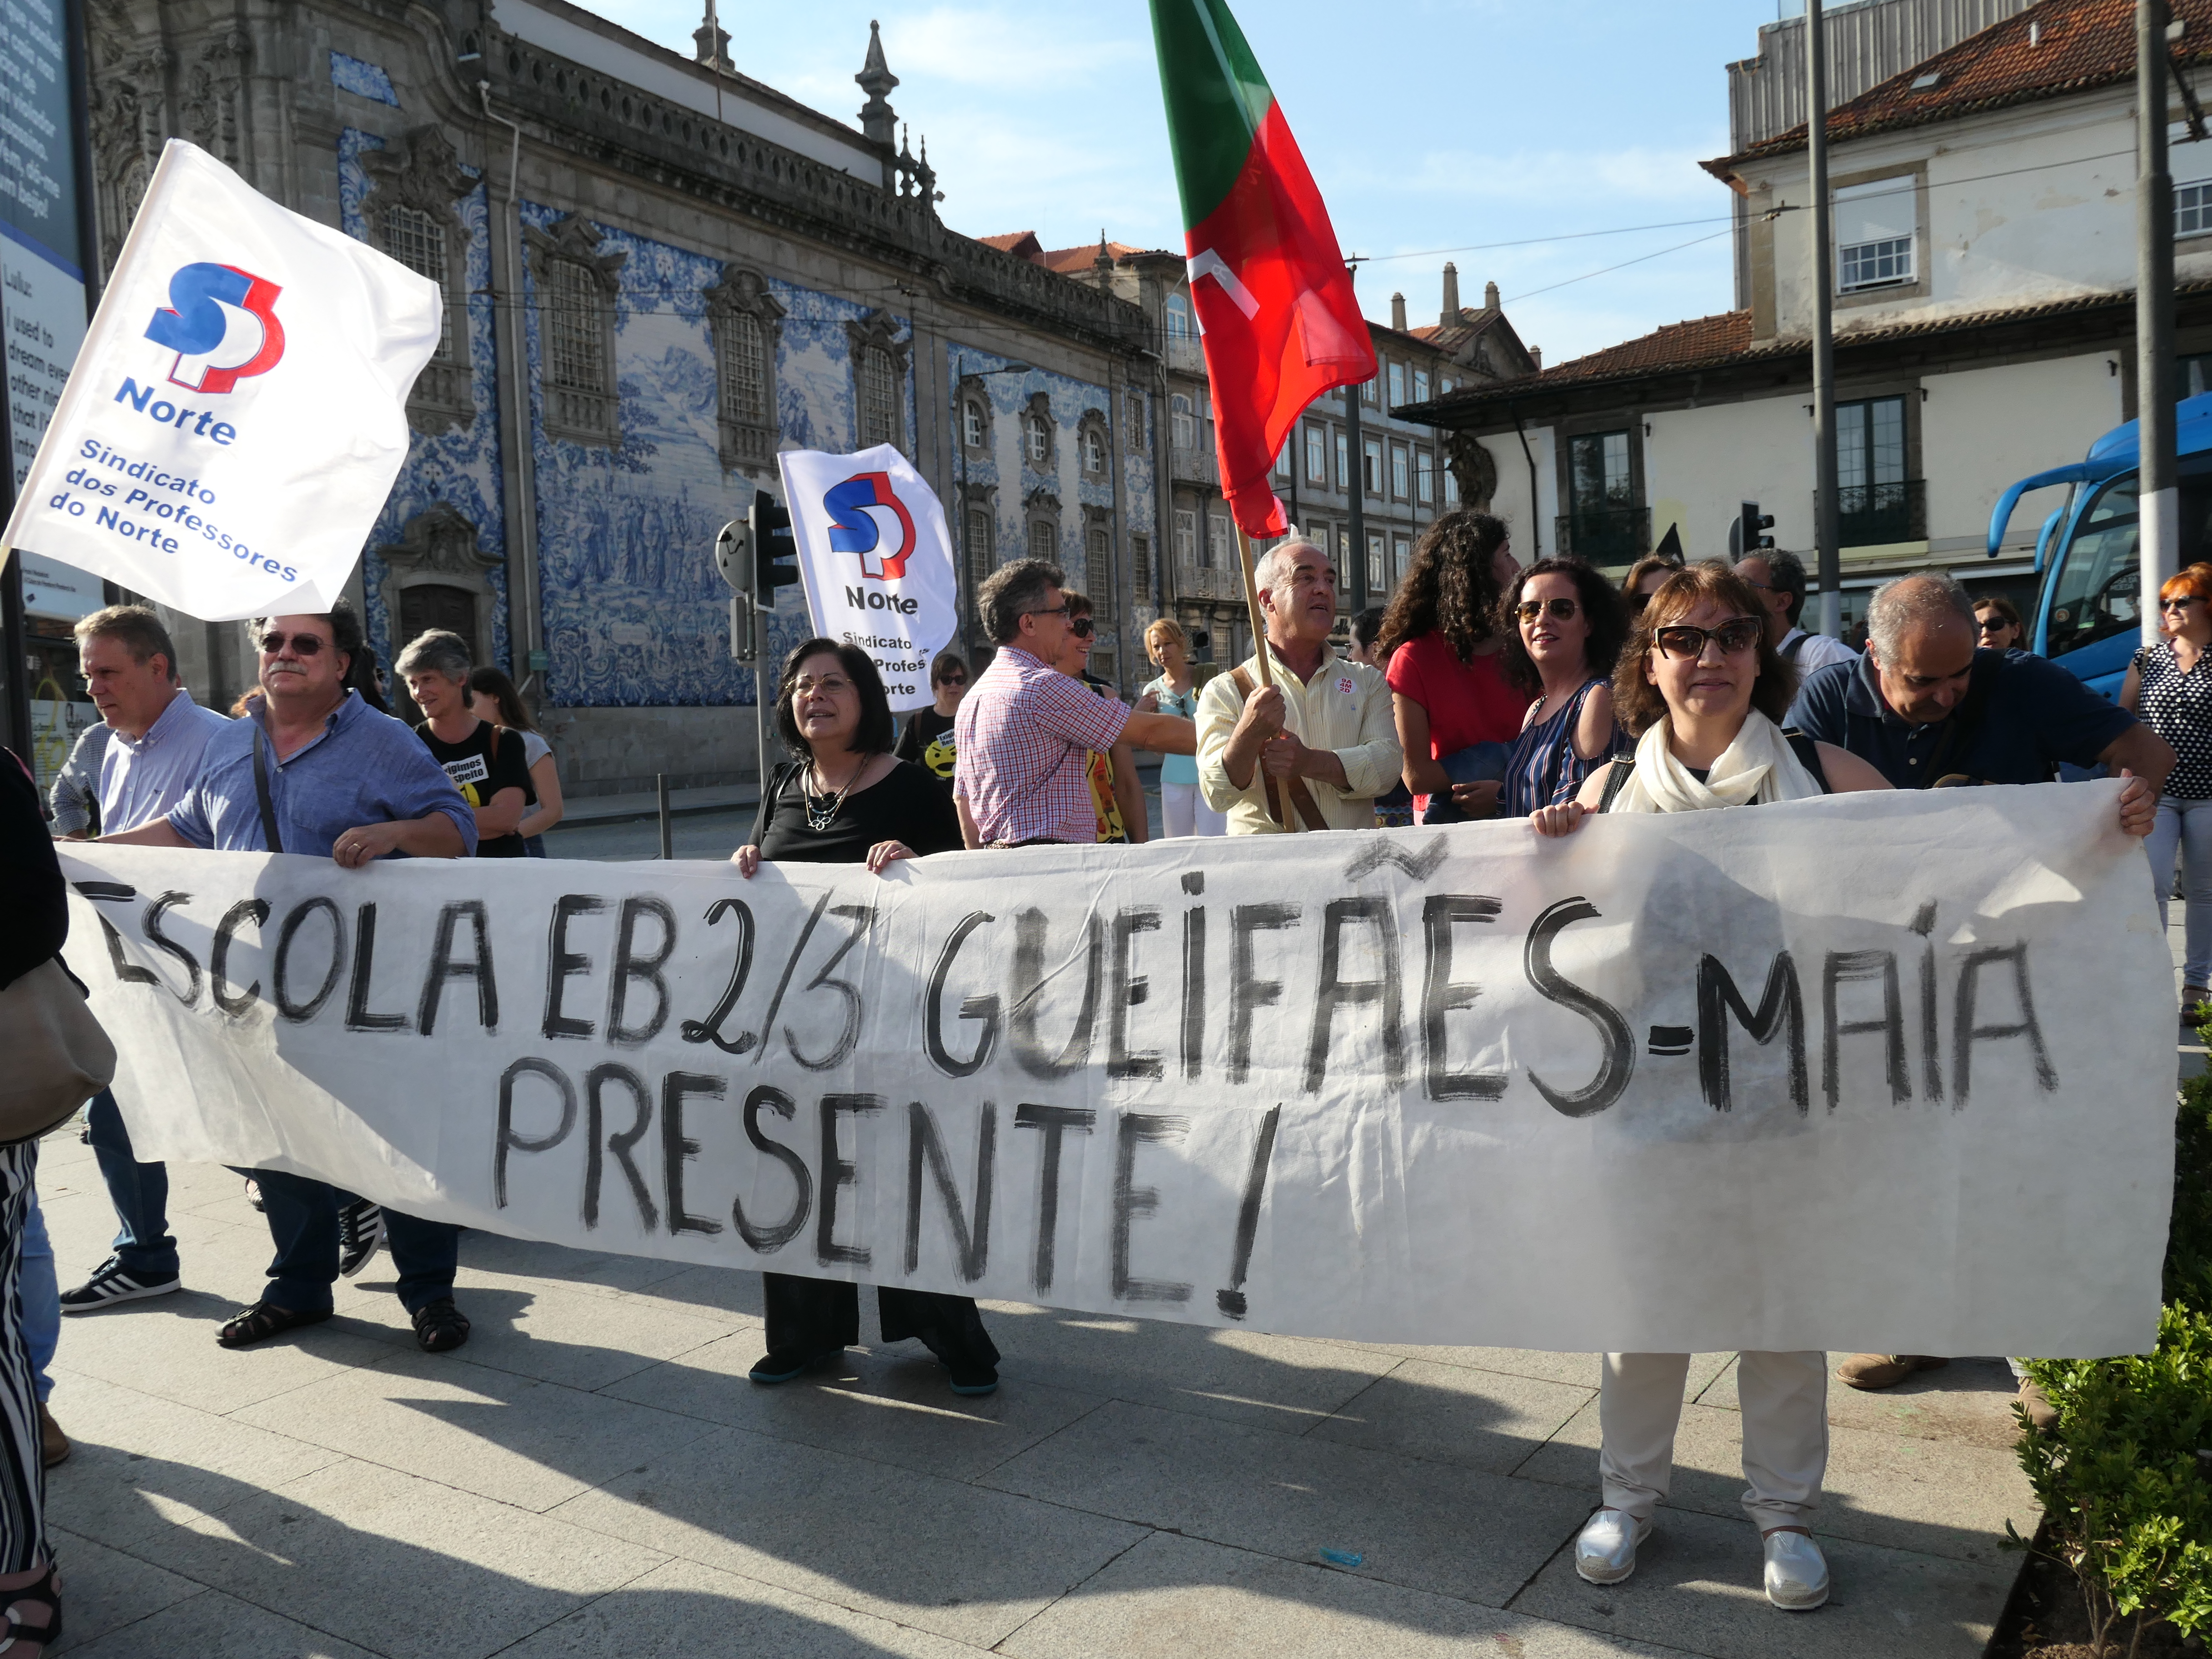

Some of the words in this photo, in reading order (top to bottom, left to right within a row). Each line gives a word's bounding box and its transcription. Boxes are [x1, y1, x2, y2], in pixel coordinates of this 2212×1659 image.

[14, 316, 39, 342] used
[43, 327, 54, 349] to
[8, 339, 45, 374] dream
[10, 373, 40, 400] other
[13, 402, 36, 429] that
[113, 376, 237, 446] Norte
[80, 439, 216, 505] Sindicato
[49, 491, 85, 517] do
[96, 506, 179, 554] Norte
[65, 467, 118, 497] dos
[124, 488, 298, 583] Professores
[845, 585, 918, 615] Norte
[843, 632, 912, 649] Sindicato
[884, 683, 915, 695] orte
[71, 880, 498, 1037] ESCOLA
[542, 891, 678, 1048] EB
[681, 886, 878, 1073] 2/3
[494, 1056, 1282, 1322] PRESENTE!
